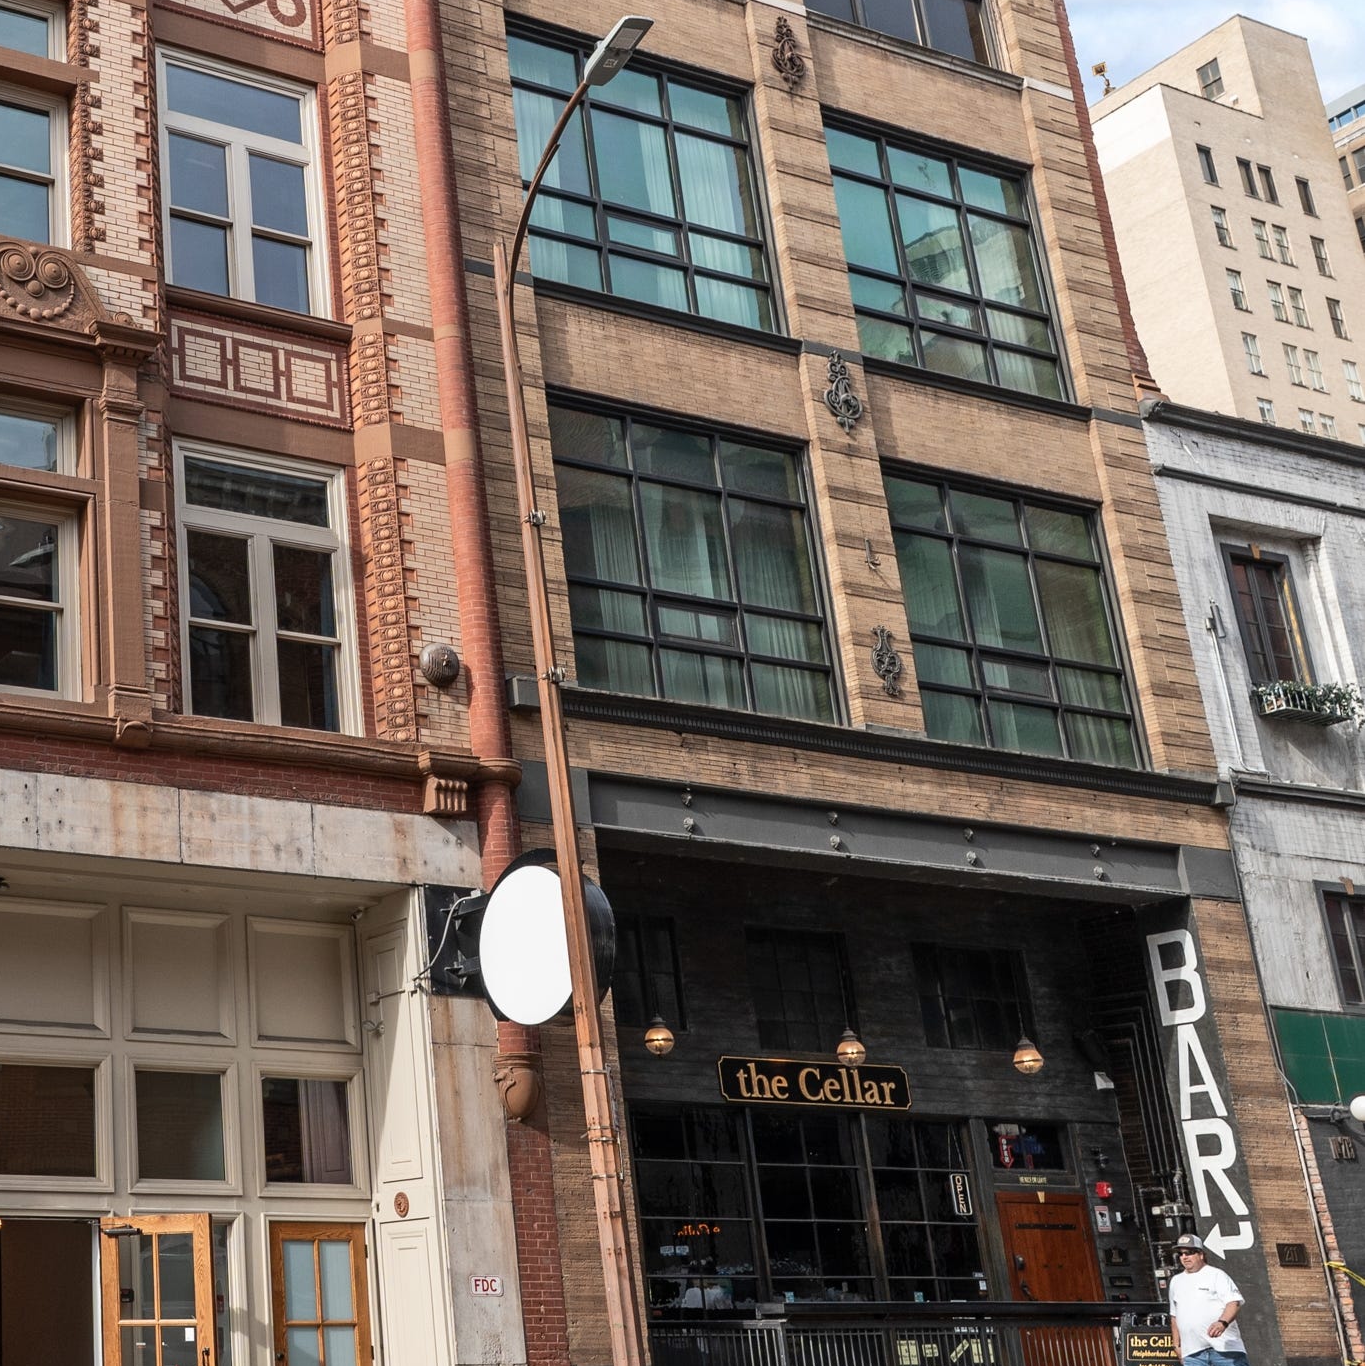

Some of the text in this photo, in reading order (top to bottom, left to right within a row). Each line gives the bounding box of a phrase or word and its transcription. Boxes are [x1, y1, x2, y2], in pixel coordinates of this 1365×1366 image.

[736, 1062, 896, 1105] the Cellar
[1146, 929, 1249, 1217] BAR
[1001, 1138, 1010, 1163] OPEN
[955, 1175, 967, 1213] OPEN
[474, 1279, 497, 1292] FDC
[1130, 1336, 1173, 1347] the Cell
[1132, 1350, 1170, 1358] Neighborhood
